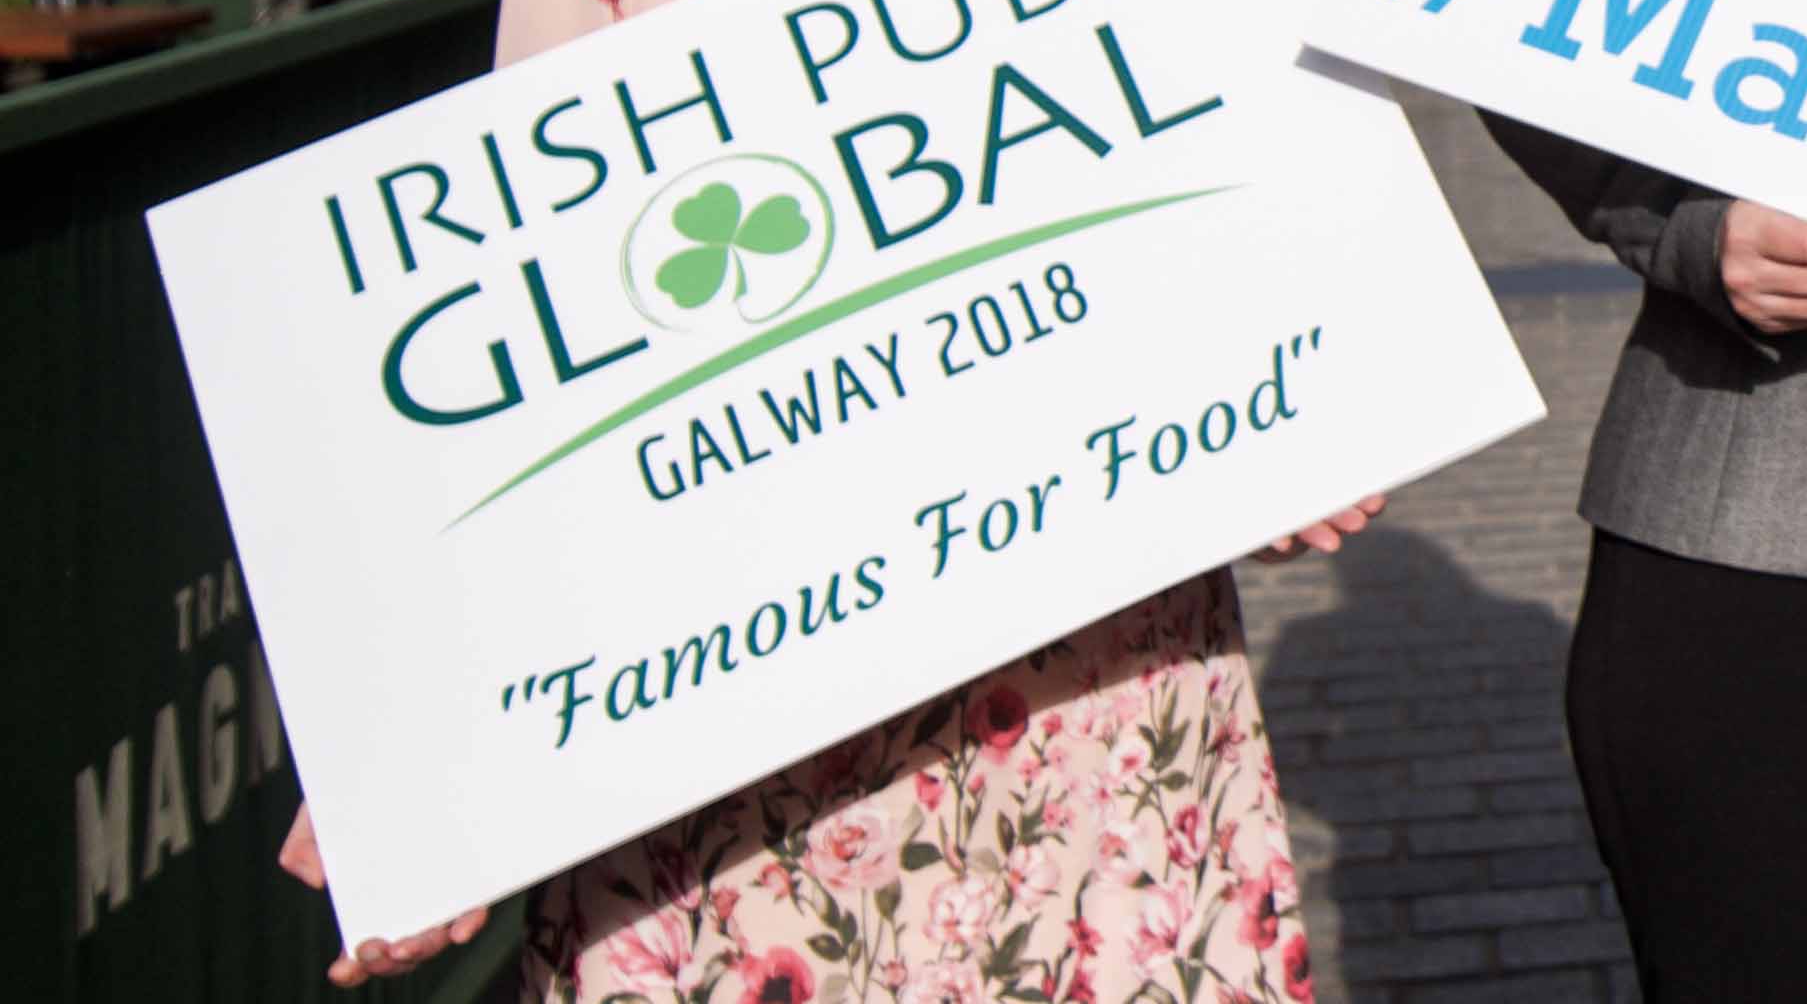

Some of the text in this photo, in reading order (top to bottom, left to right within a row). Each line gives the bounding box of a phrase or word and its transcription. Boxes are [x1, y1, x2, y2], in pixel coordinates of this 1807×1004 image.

[326, 51, 733, 294] IRISH
[637, 262, 1089, 502] GALWAY 2018
[914, 474, 1062, 579] For
